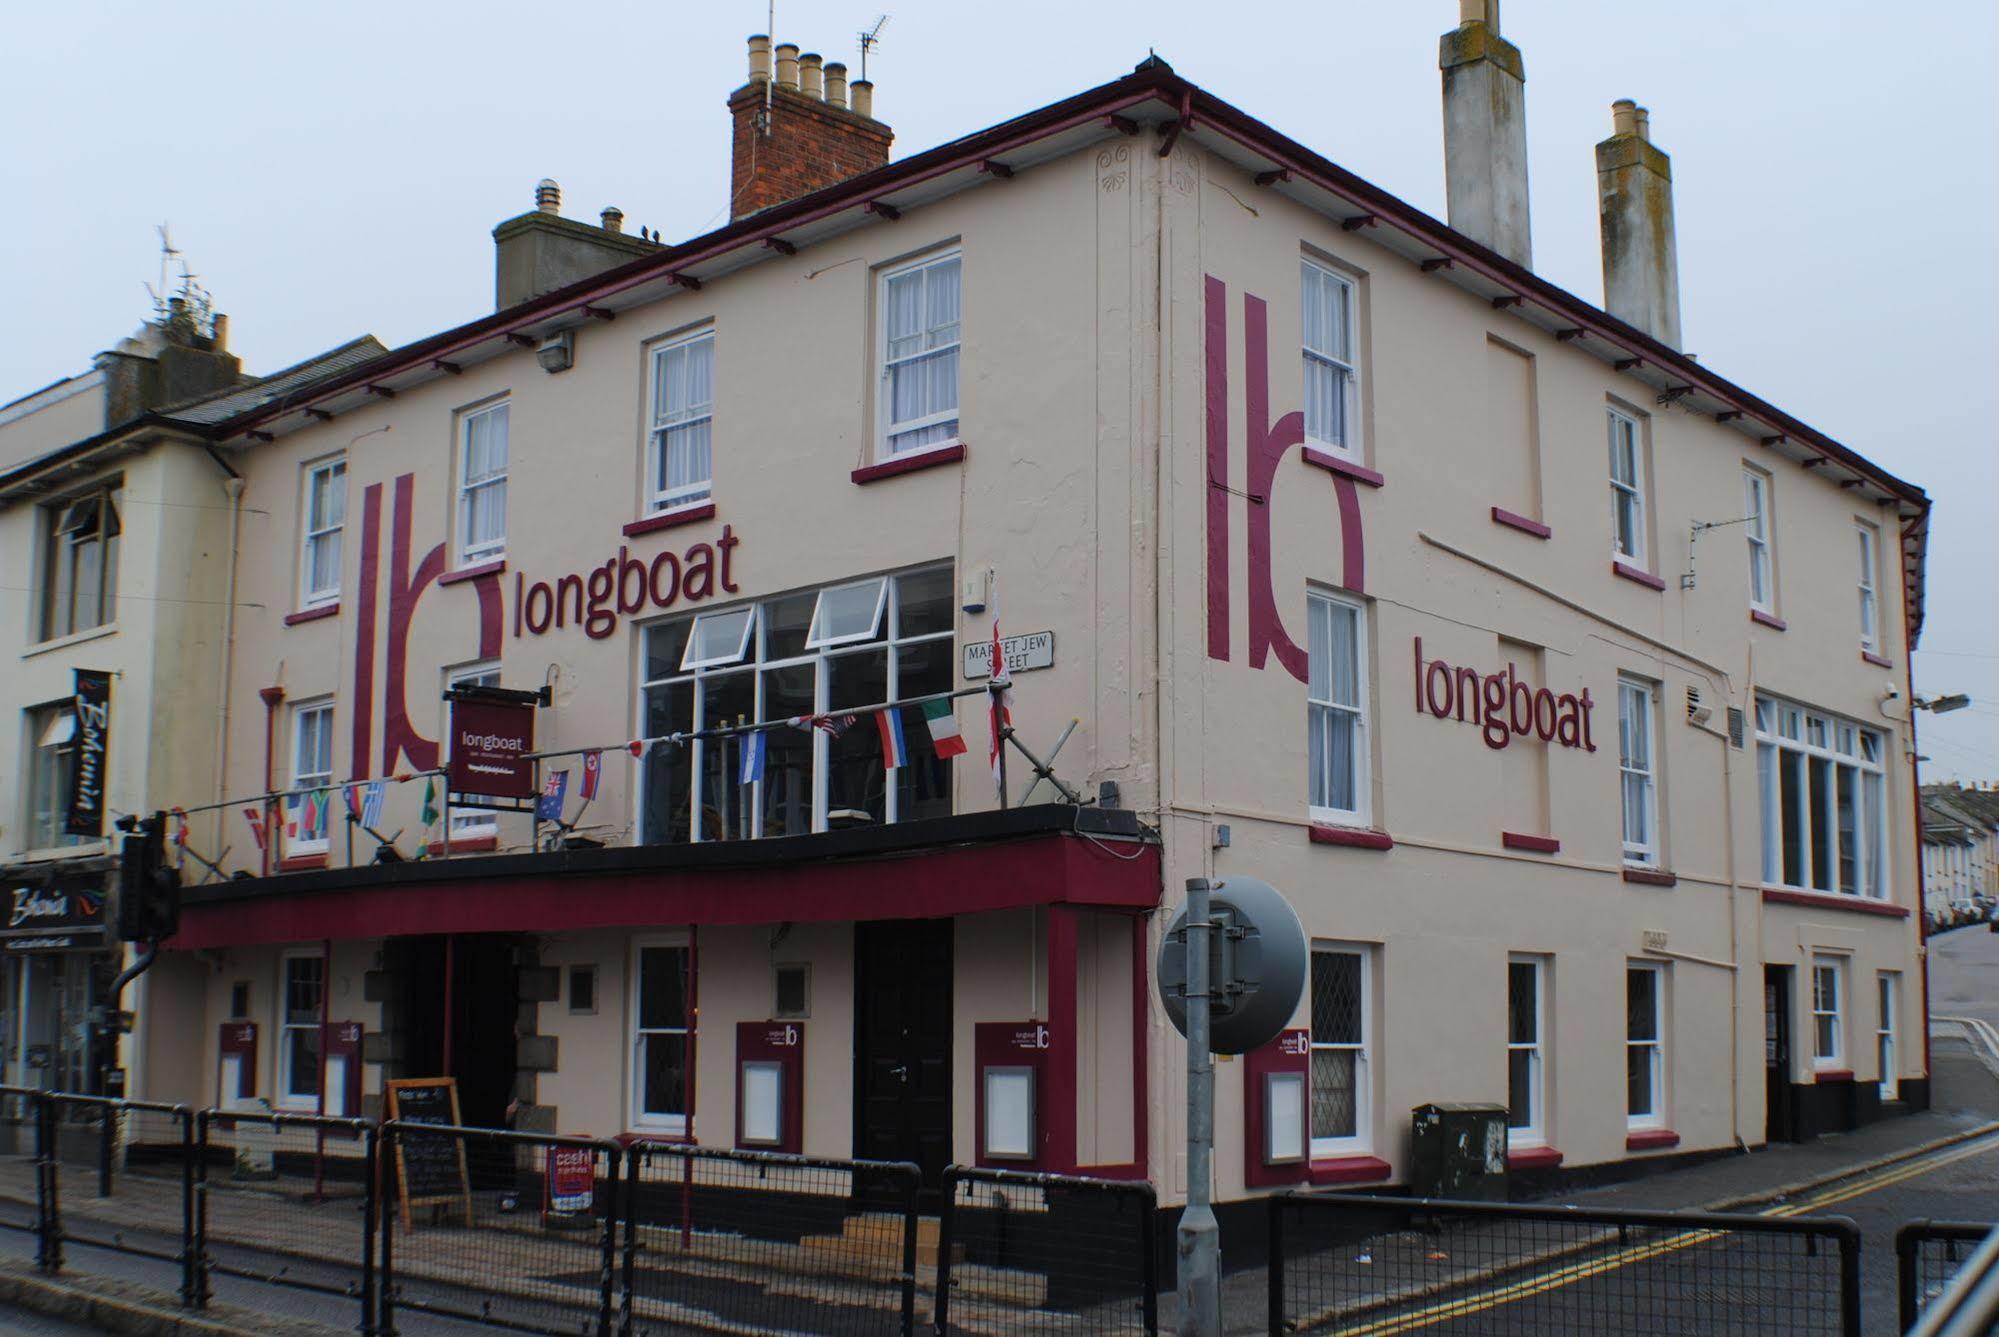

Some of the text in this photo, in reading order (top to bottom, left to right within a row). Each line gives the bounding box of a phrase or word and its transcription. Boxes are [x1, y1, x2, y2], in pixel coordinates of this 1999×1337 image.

[514, 524, 739, 640] longboat
[968, 635, 1047, 660] MARET JEW
[986, 653, 1029, 672] SEET
[1414, 636, 1597, 752] longboat
[462, 730, 523, 751] longboat
